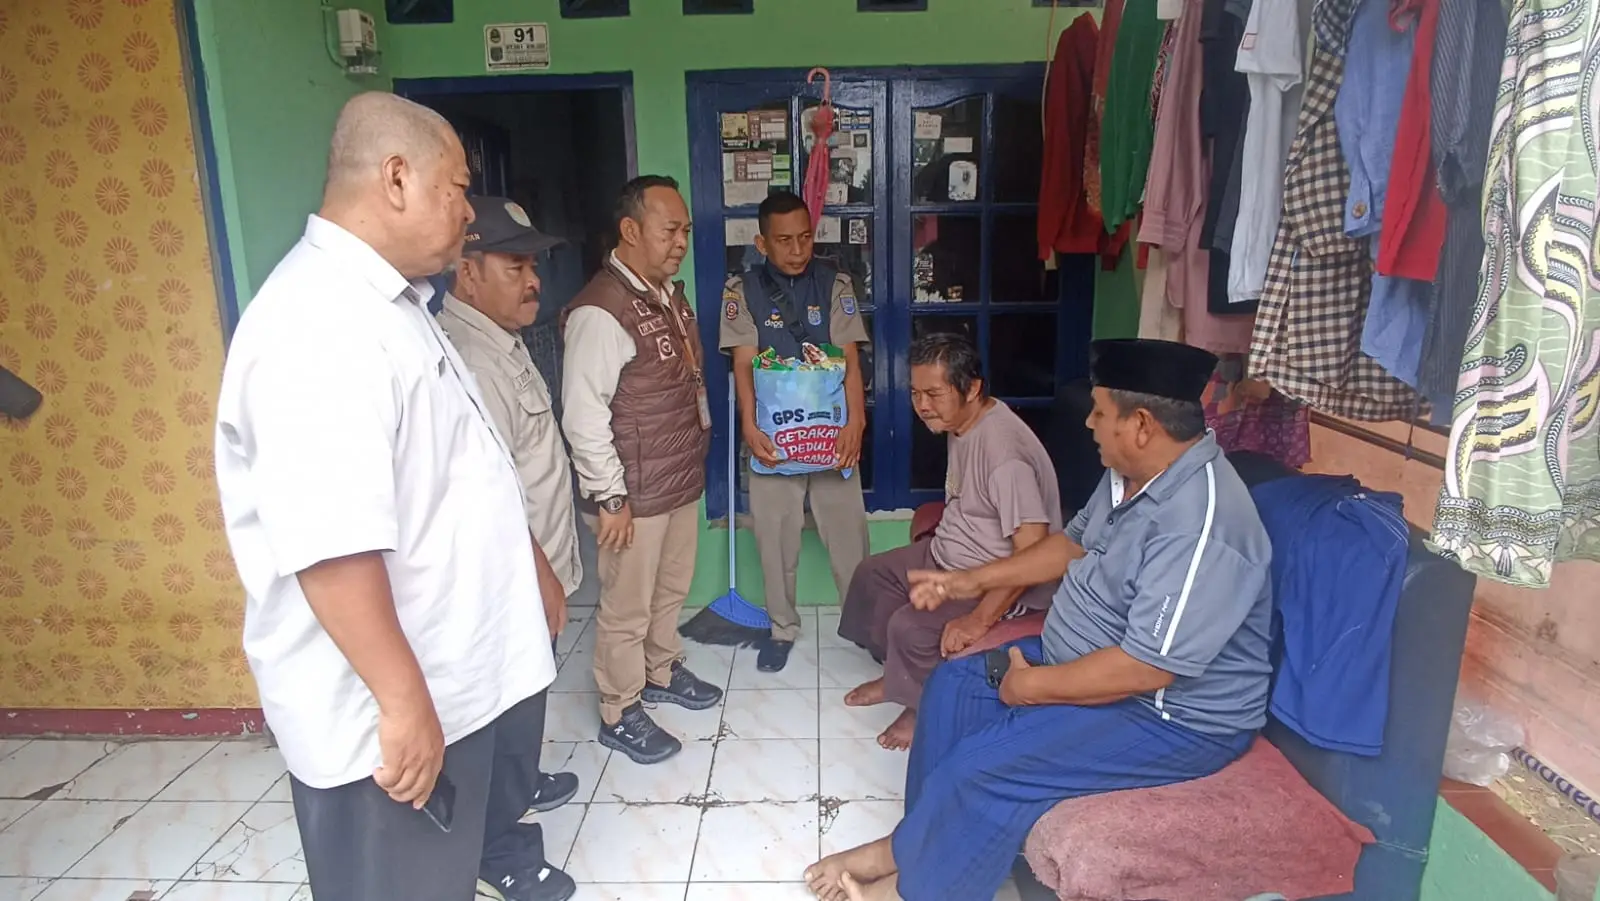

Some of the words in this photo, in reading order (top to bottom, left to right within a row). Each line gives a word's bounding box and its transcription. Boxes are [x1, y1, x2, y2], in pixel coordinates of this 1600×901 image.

[514, 27, 534, 42] 91
[772, 408, 804, 425] GPS
[788, 441, 833, 456] PEDULI
